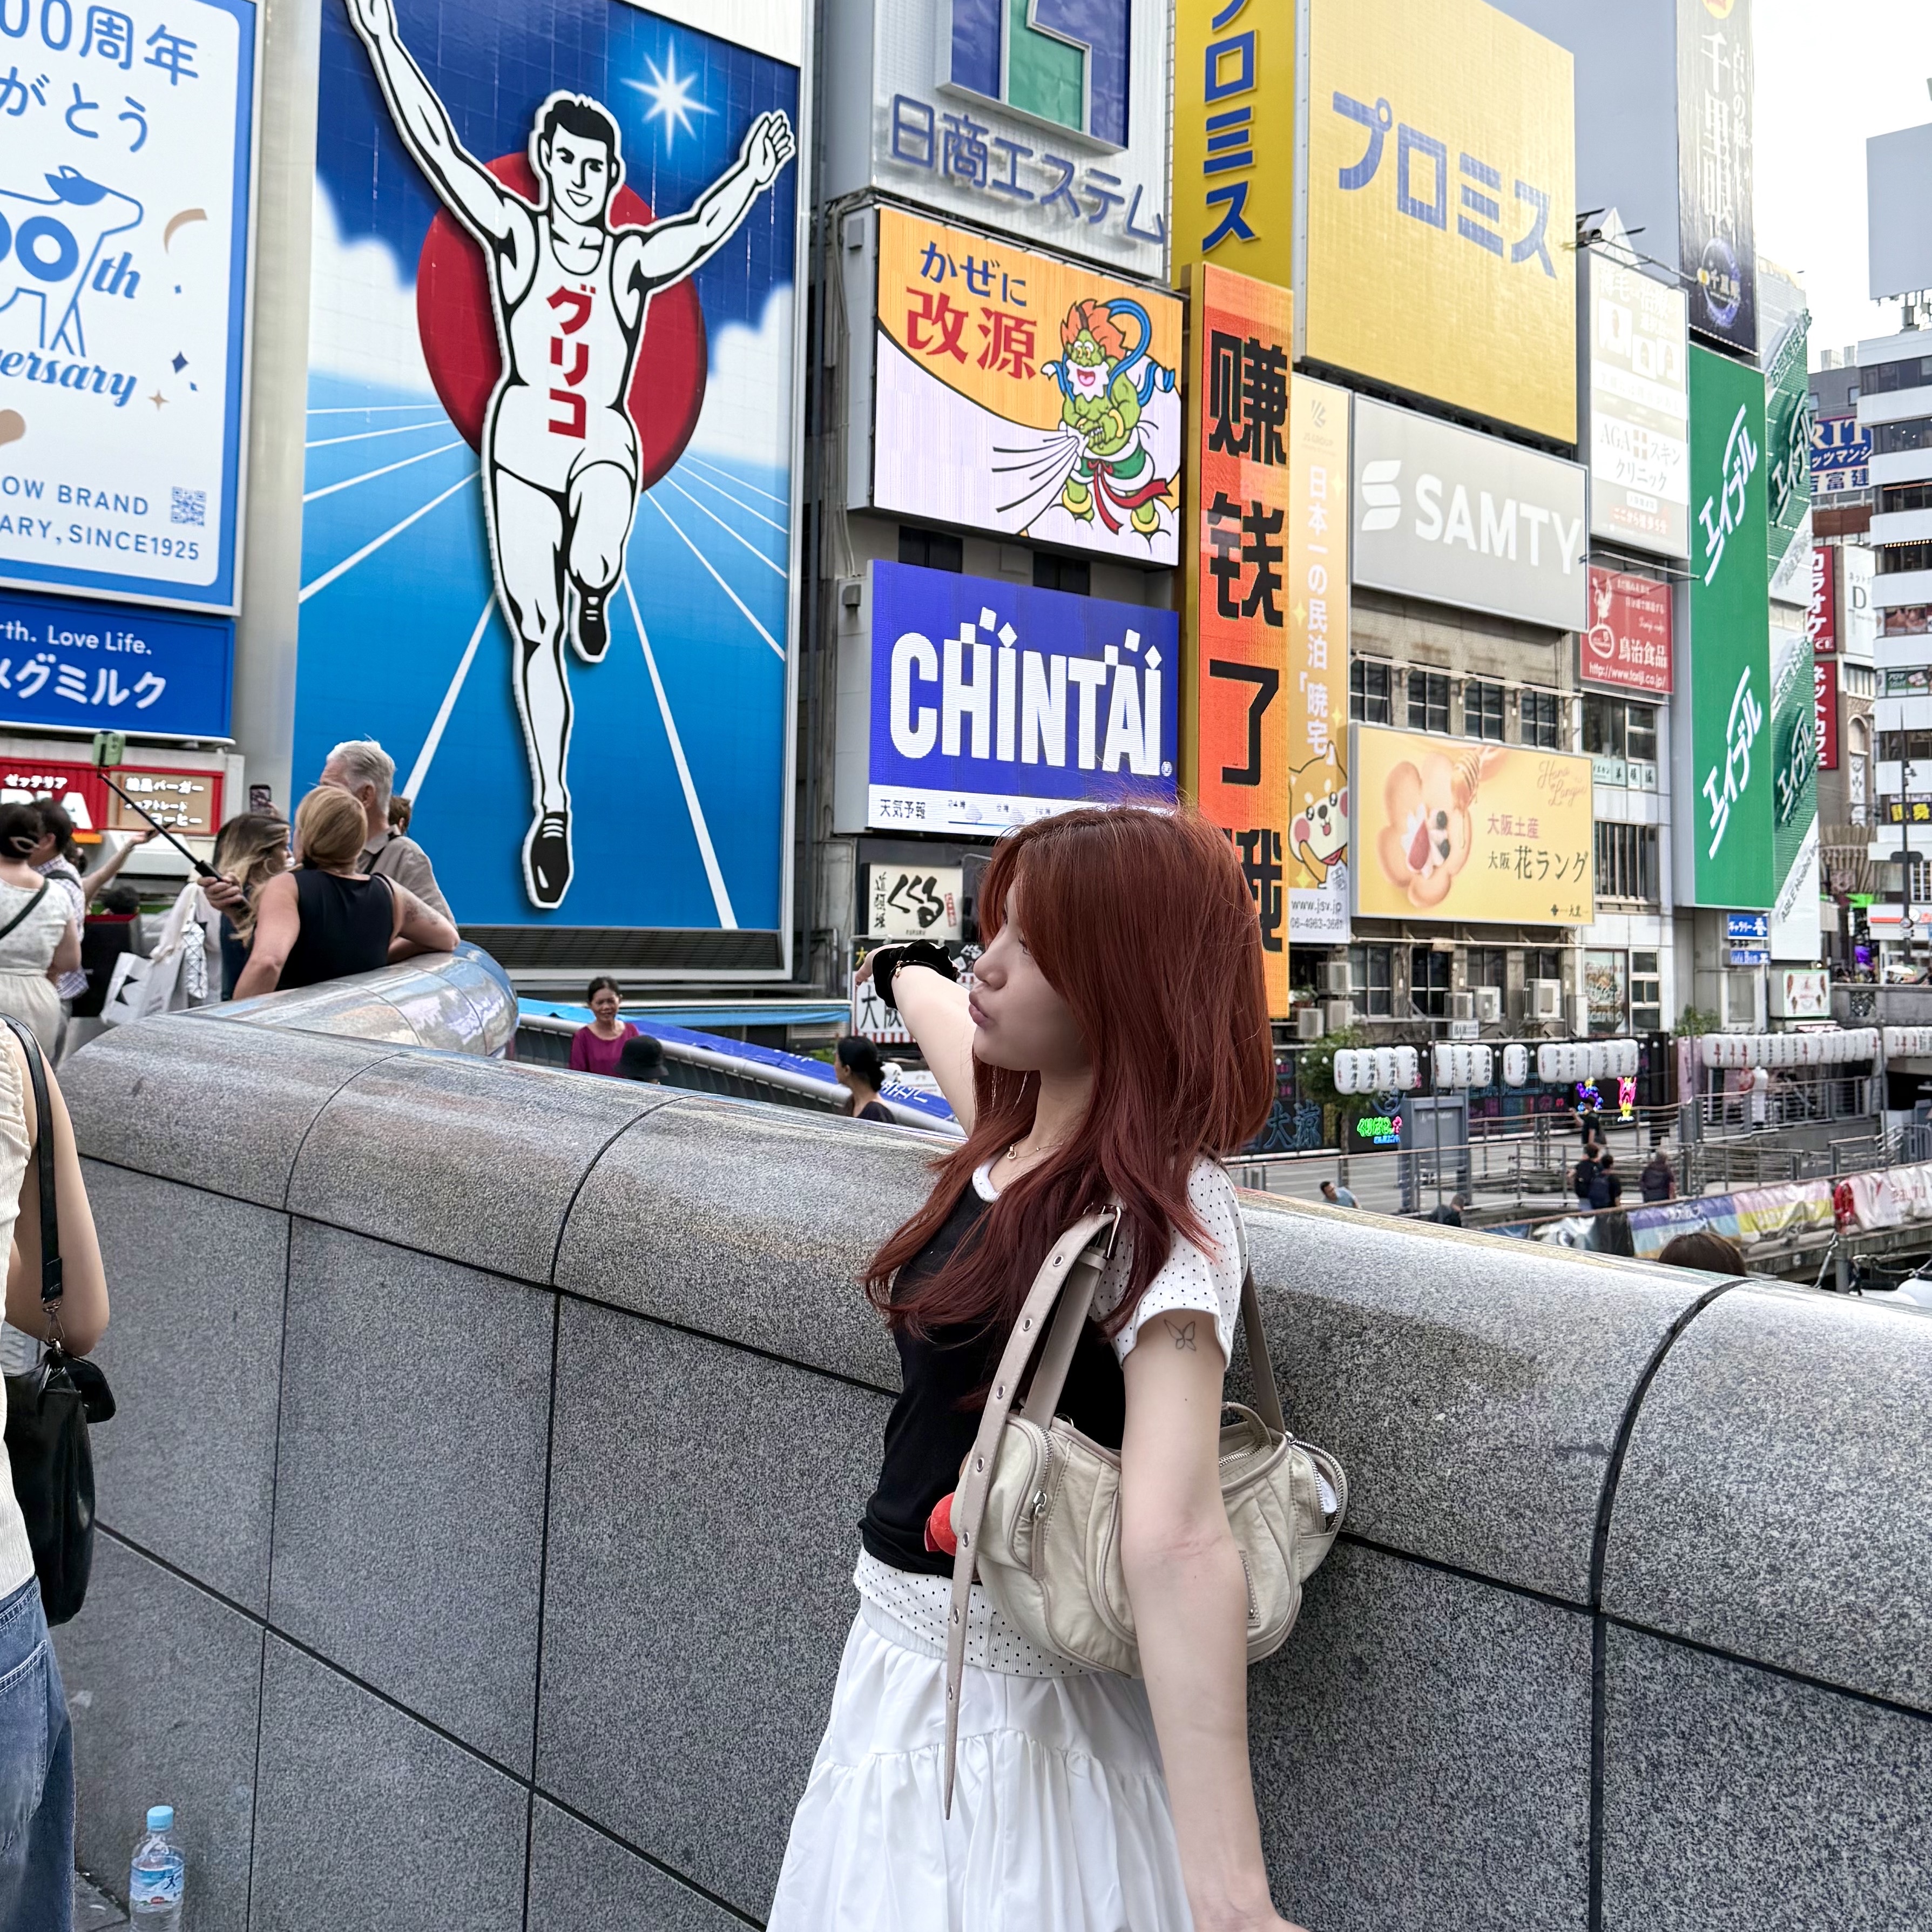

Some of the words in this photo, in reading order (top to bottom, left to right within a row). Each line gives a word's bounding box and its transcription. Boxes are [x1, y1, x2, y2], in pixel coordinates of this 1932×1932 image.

[893, 93, 1165, 245] 日商エステム
[1333, 90, 1558, 280] プロミス
[920, 240, 1027, 307] かぜに
[546, 283, 596, 440] グリコ
[906, 286, 1038, 381] 改源
[0, 348, 138, 407] ersary
[1600, 422, 1631, 452] AGA
[58, 484, 149, 516] BRAND
[1616, 458, 1668, 492] クリニック
[1698, 402, 1759, 587] エイブル
[1415, 472, 1582, 576] SAMTY
[48, 625, 99, 649] Love
[105, 631, 152, 656] Life.
[889, 606, 1162, 776] CHINTAI
[4, 774, 68, 789] ゼッテリア
[1702, 664, 1763, 861] エイブル
[880, 799, 926, 819] 天気予報
[1487, 813, 1539, 839] 大阪土産
[1488, 850, 1511, 870] 大阪
[1514, 845, 1589, 883] 花ラング
[887, 874, 945, 929] くくる
